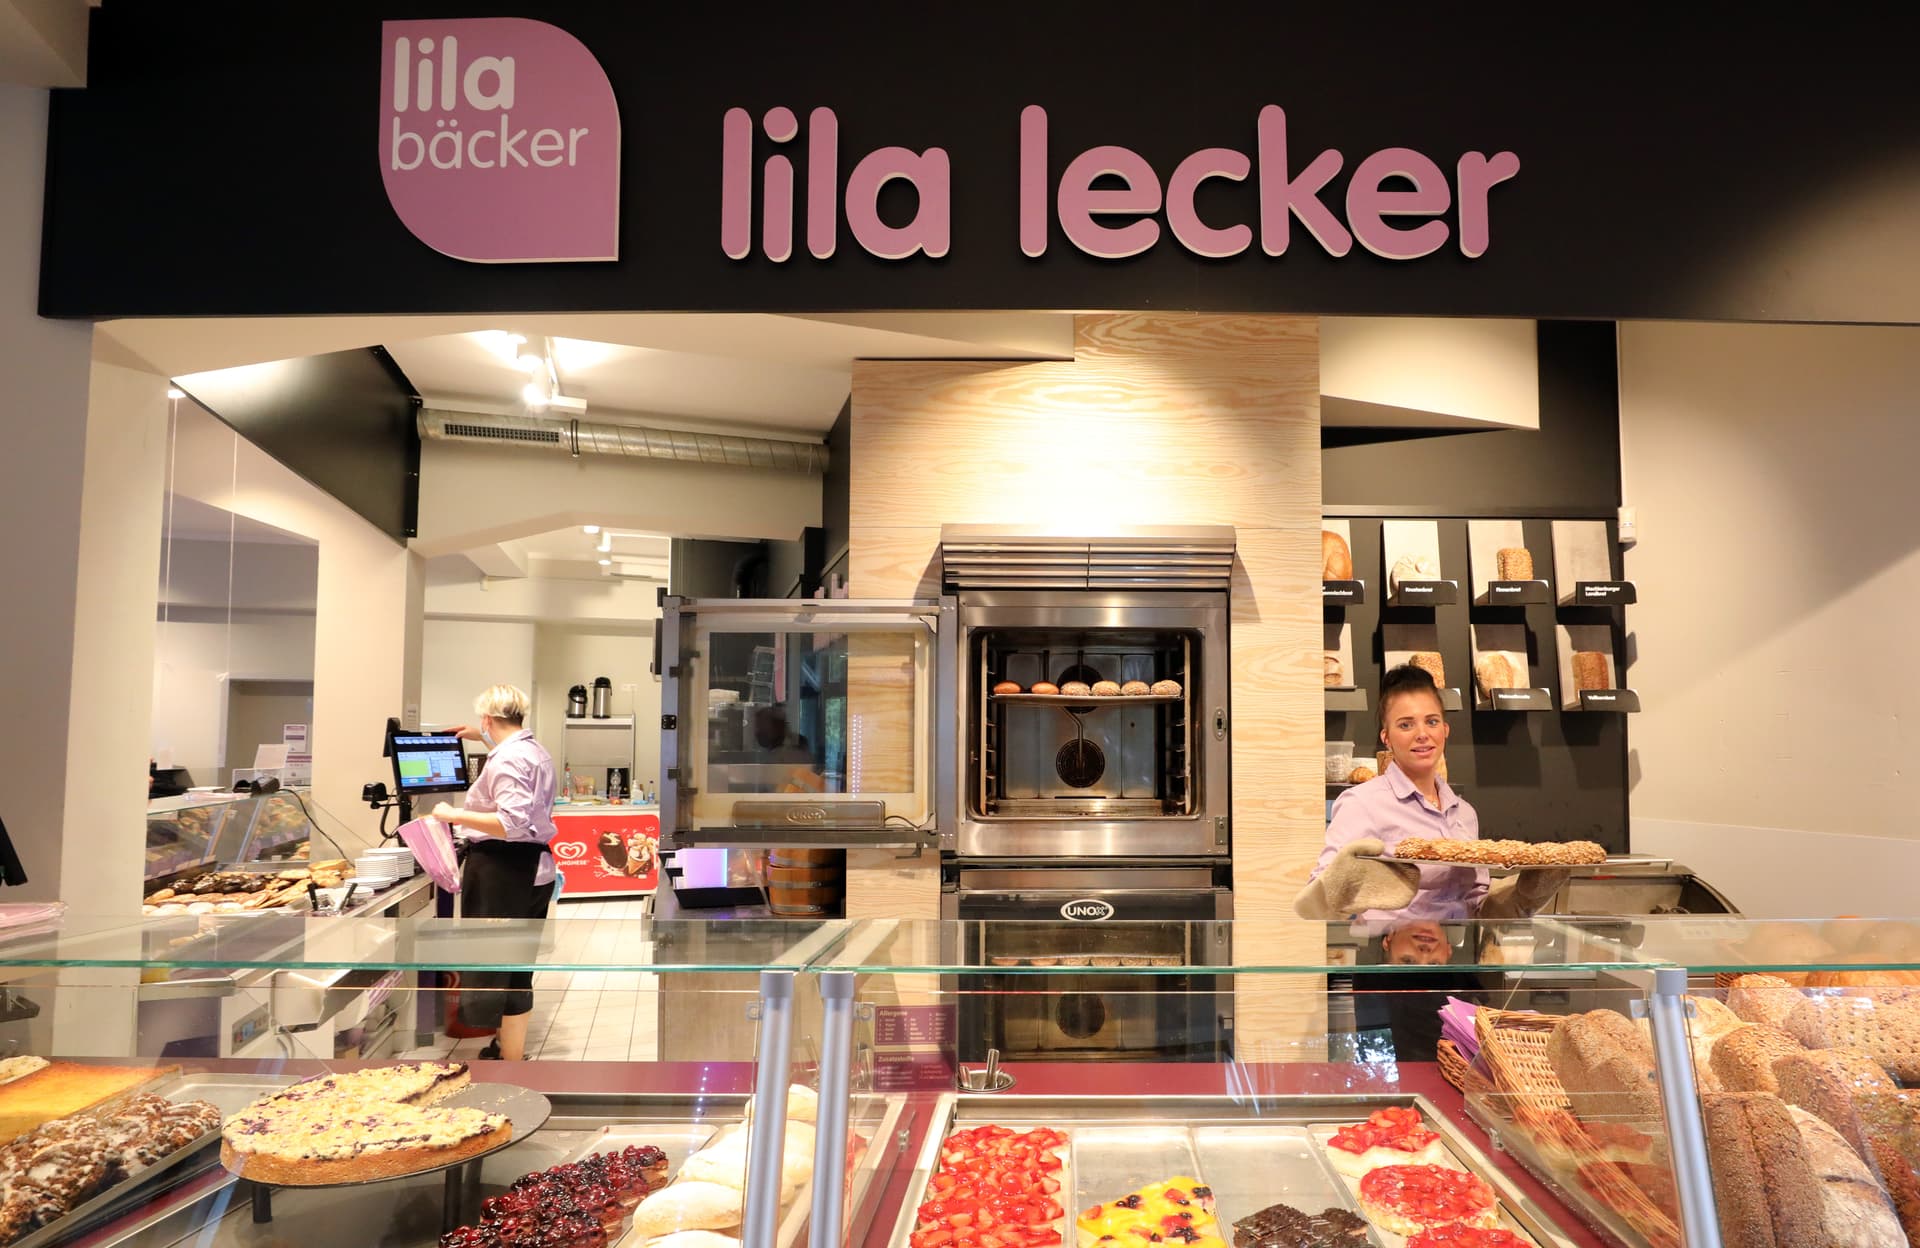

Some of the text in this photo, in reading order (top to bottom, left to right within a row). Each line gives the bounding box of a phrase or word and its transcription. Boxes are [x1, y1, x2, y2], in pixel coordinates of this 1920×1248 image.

[394, 36, 515, 112] lila
[392, 114, 589, 170] bäcker
[721, 104, 1521, 263] lila lecker
[1067, 905, 1106, 917] UNOX
